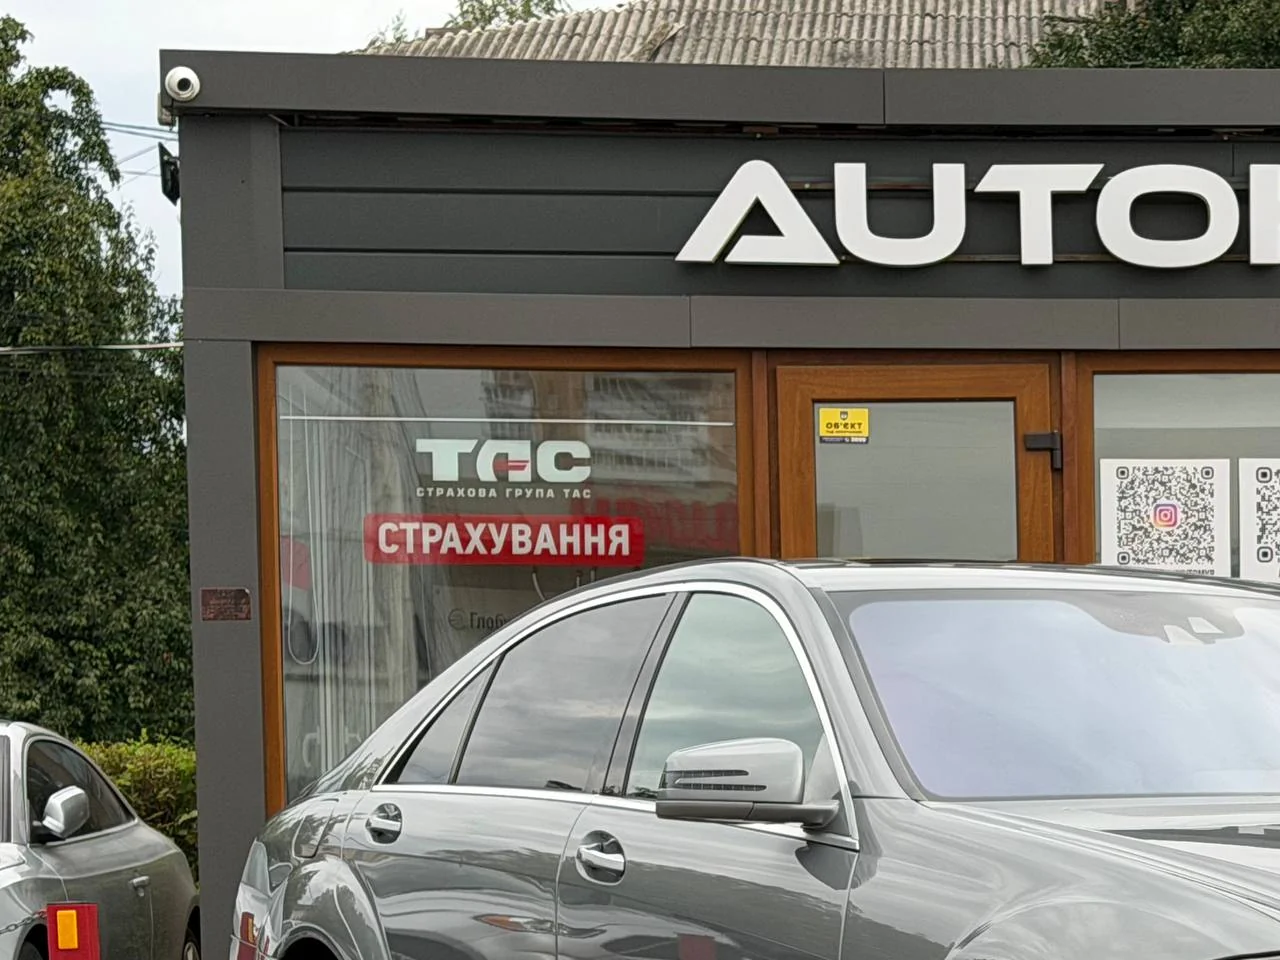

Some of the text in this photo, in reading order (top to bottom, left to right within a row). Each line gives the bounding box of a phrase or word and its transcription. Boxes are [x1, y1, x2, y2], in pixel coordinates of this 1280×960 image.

[416, 487, 592, 499] СТРАХОВА ГРУПА ТАС
[378, 523, 630, 556] СТРАХУВАННЯ
[469, 611, 506, 630] Глоб
